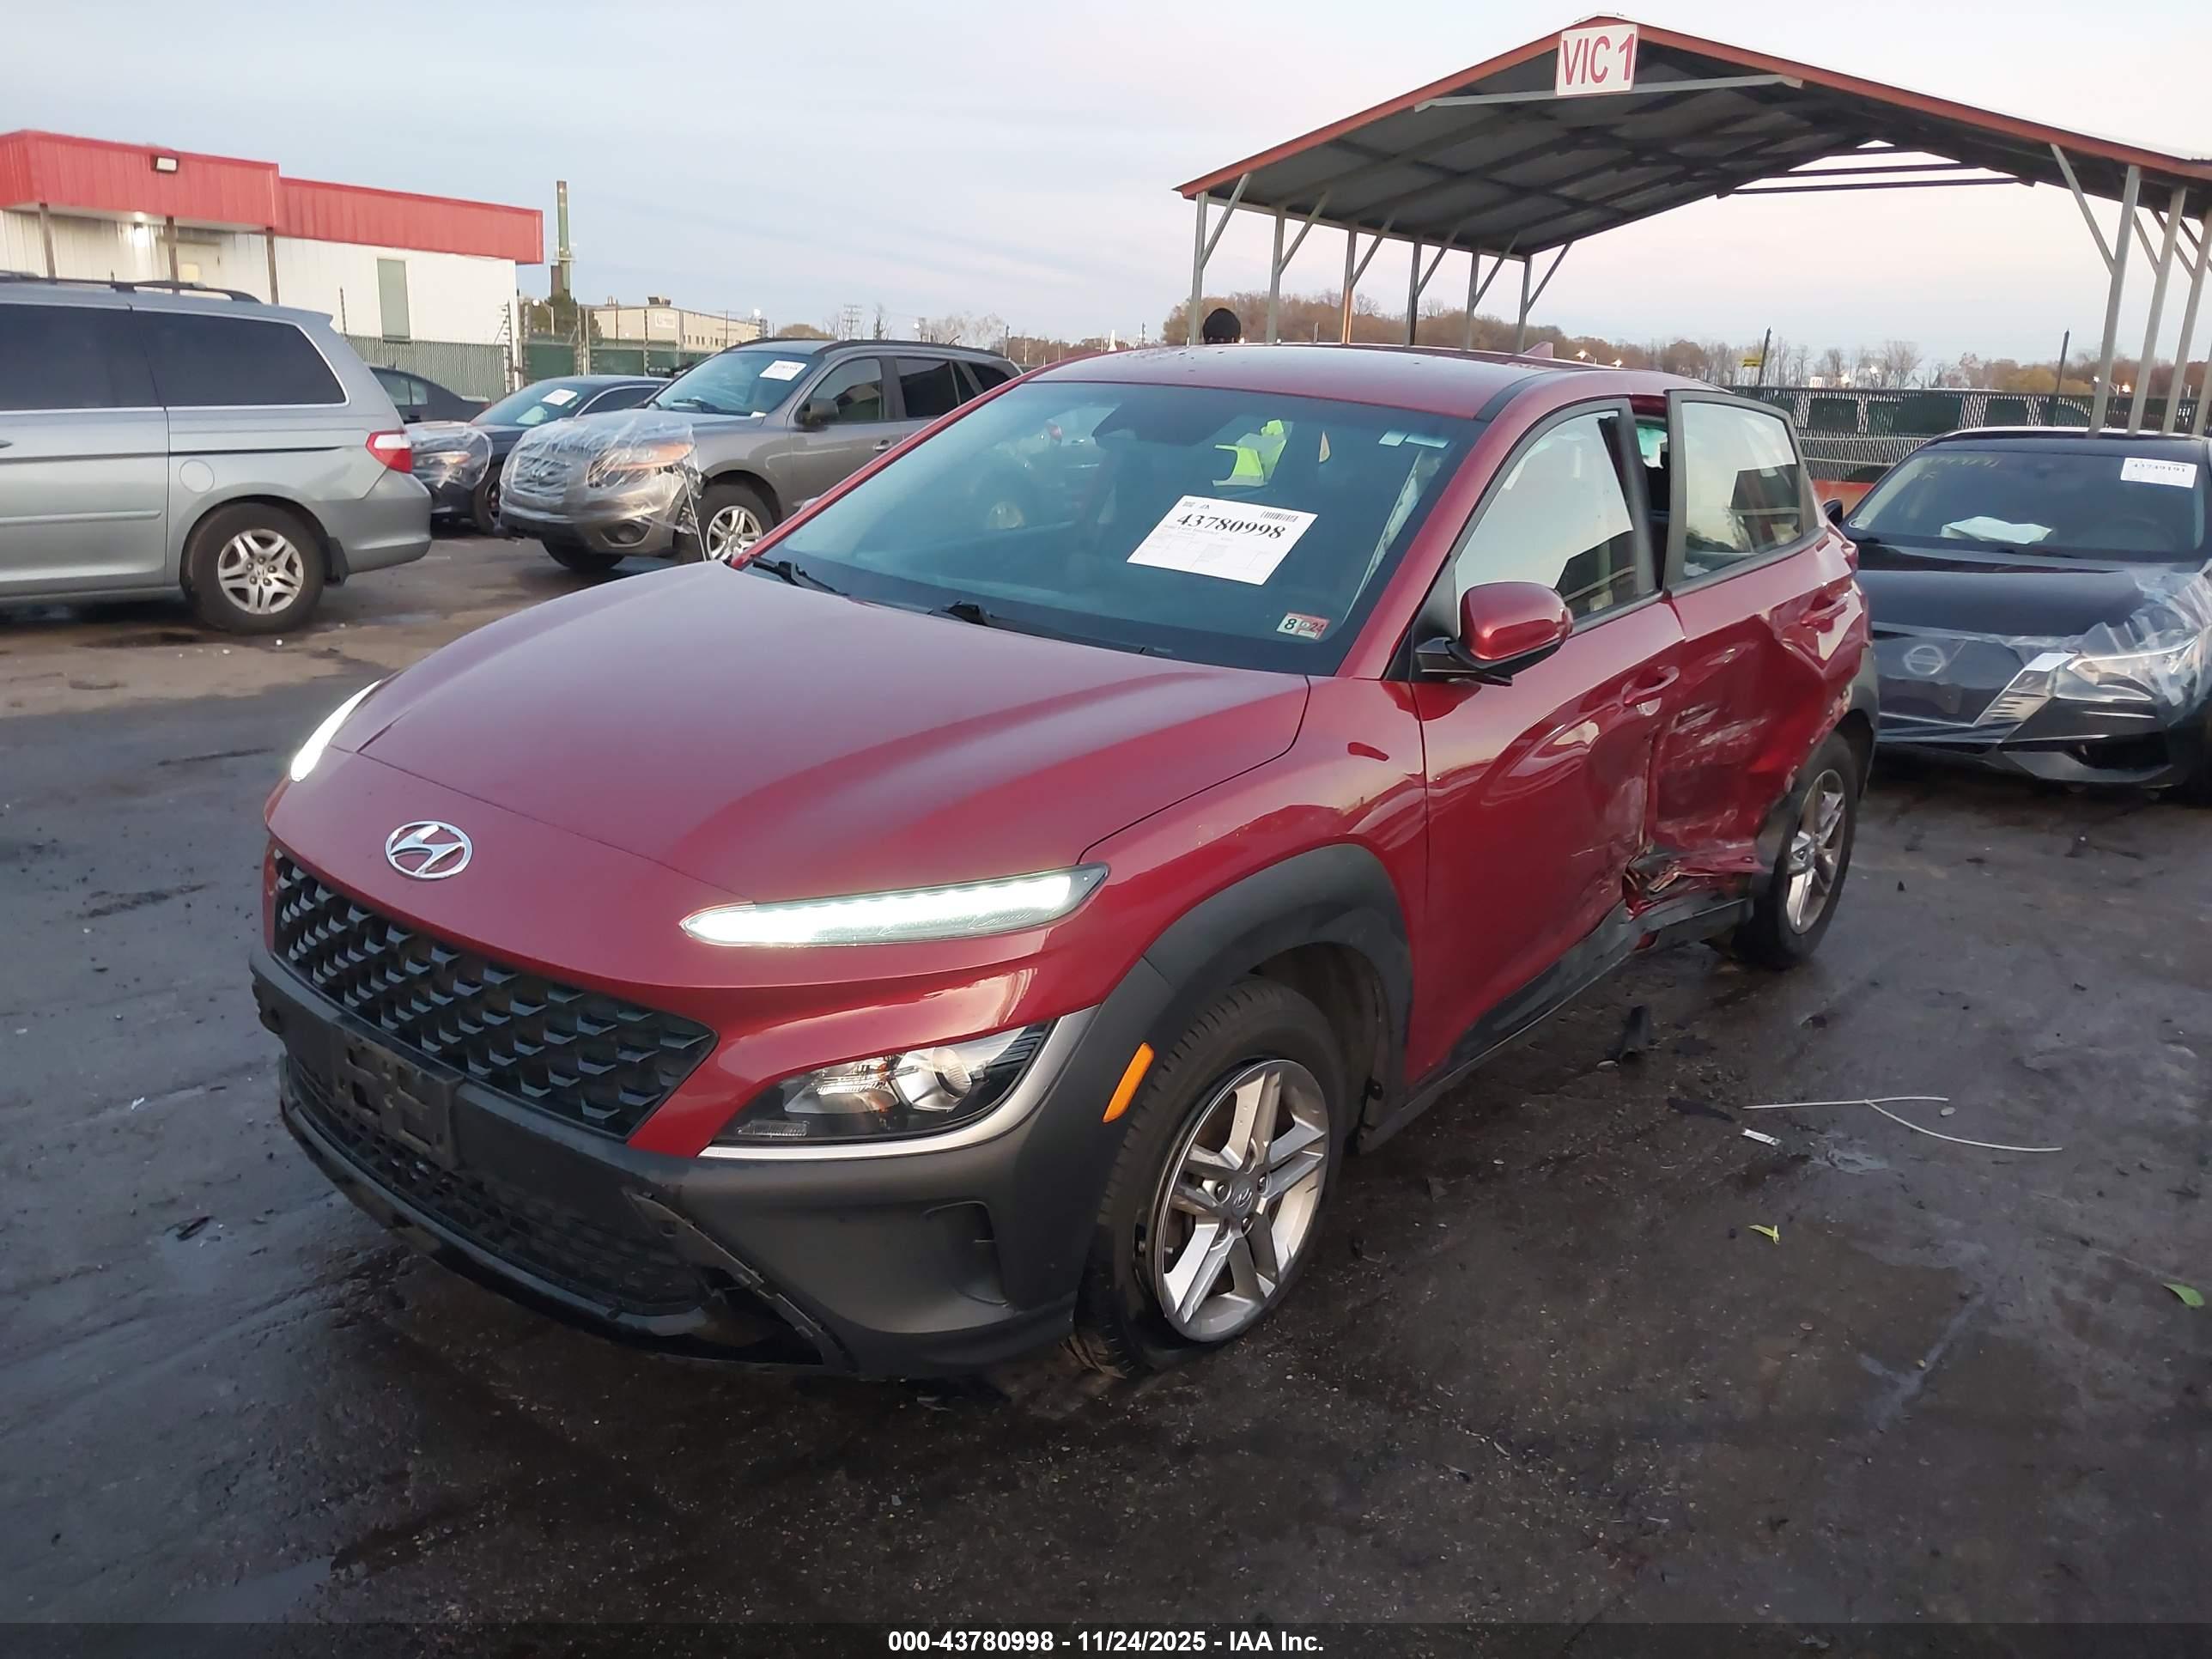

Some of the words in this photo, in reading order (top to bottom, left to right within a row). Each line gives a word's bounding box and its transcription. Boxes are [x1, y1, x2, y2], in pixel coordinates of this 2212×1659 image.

[1563, 35, 1611, 85] VIC
[1618, 33, 1635, 81] 1
[1176, 513, 1287, 540] 43780998
[1284, 618, 1297, 630] 8
[1310, 623, 1324, 633] 24
